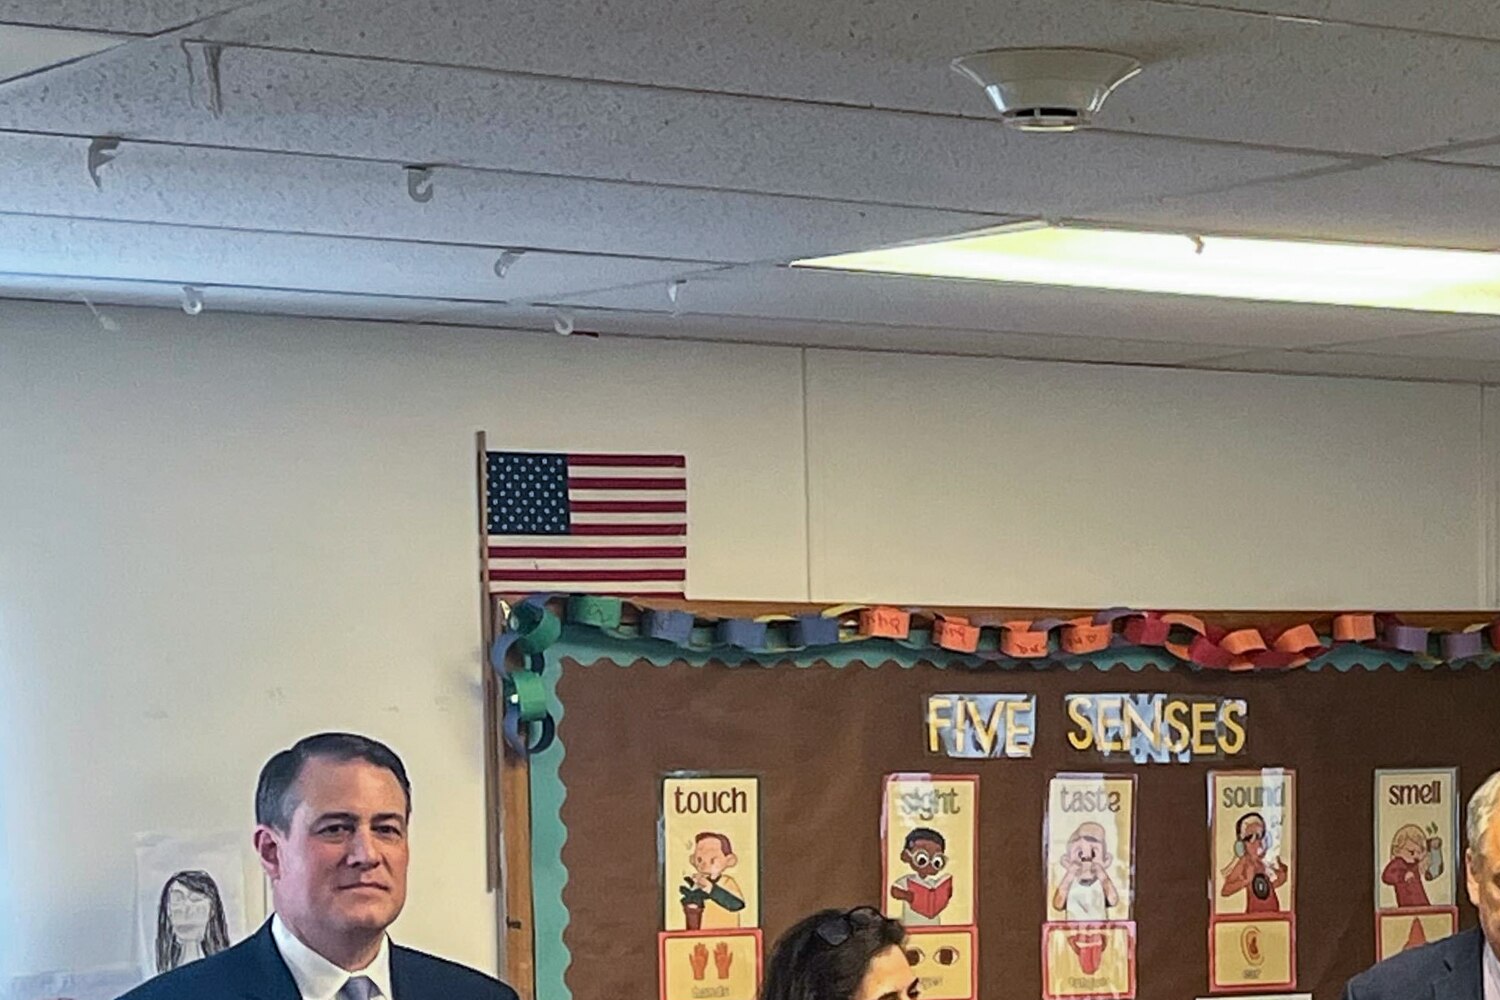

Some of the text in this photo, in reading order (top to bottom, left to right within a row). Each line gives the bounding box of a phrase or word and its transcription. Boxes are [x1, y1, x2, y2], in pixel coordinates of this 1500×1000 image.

[929, 697, 1247, 756] FIVE SENSES
[674, 786, 747, 814] touch
[899, 787, 961, 820] sight
[1060, 783, 1121, 813] taste
[1223, 783, 1285, 808] sound
[1389, 781, 1441, 806] smell
